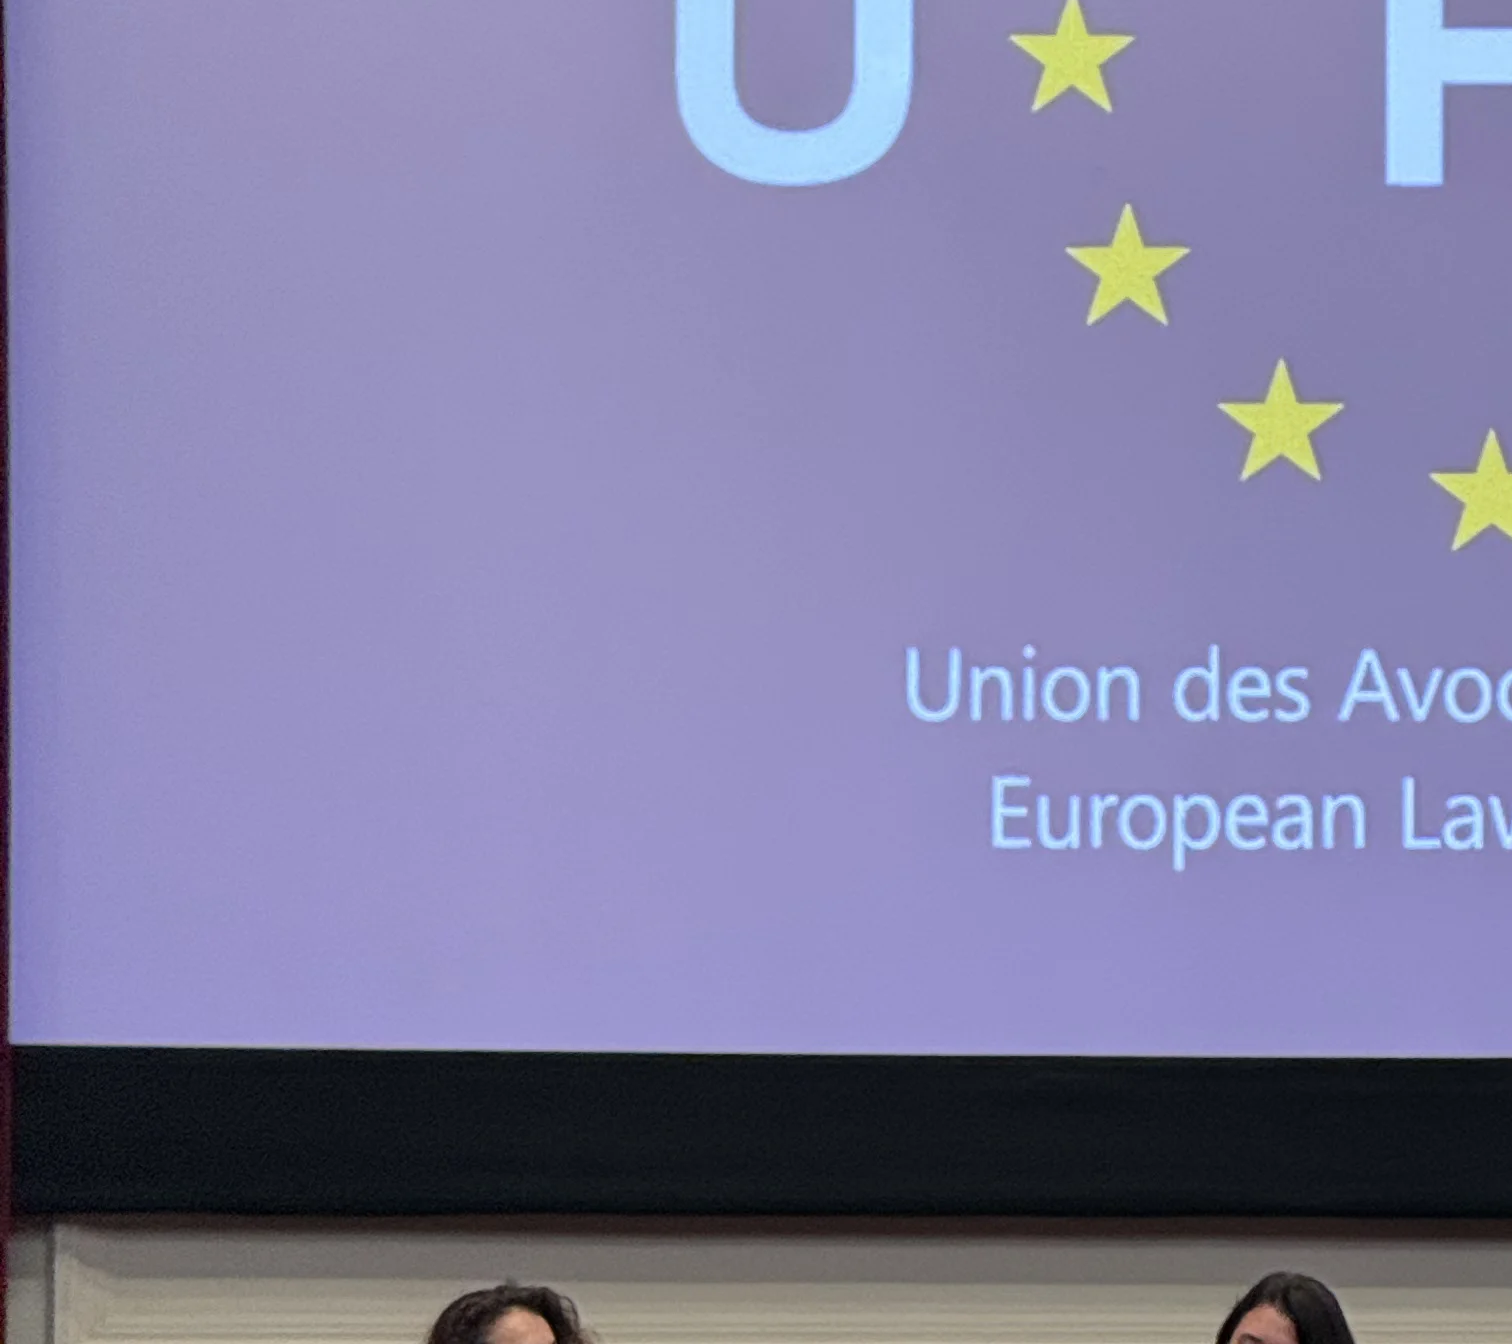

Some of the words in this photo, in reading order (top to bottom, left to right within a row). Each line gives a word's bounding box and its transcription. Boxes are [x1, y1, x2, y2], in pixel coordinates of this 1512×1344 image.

[905, 644, 1140, 722] Union
[1173, 644, 1311, 722] des
[991, 775, 1366, 872] European
